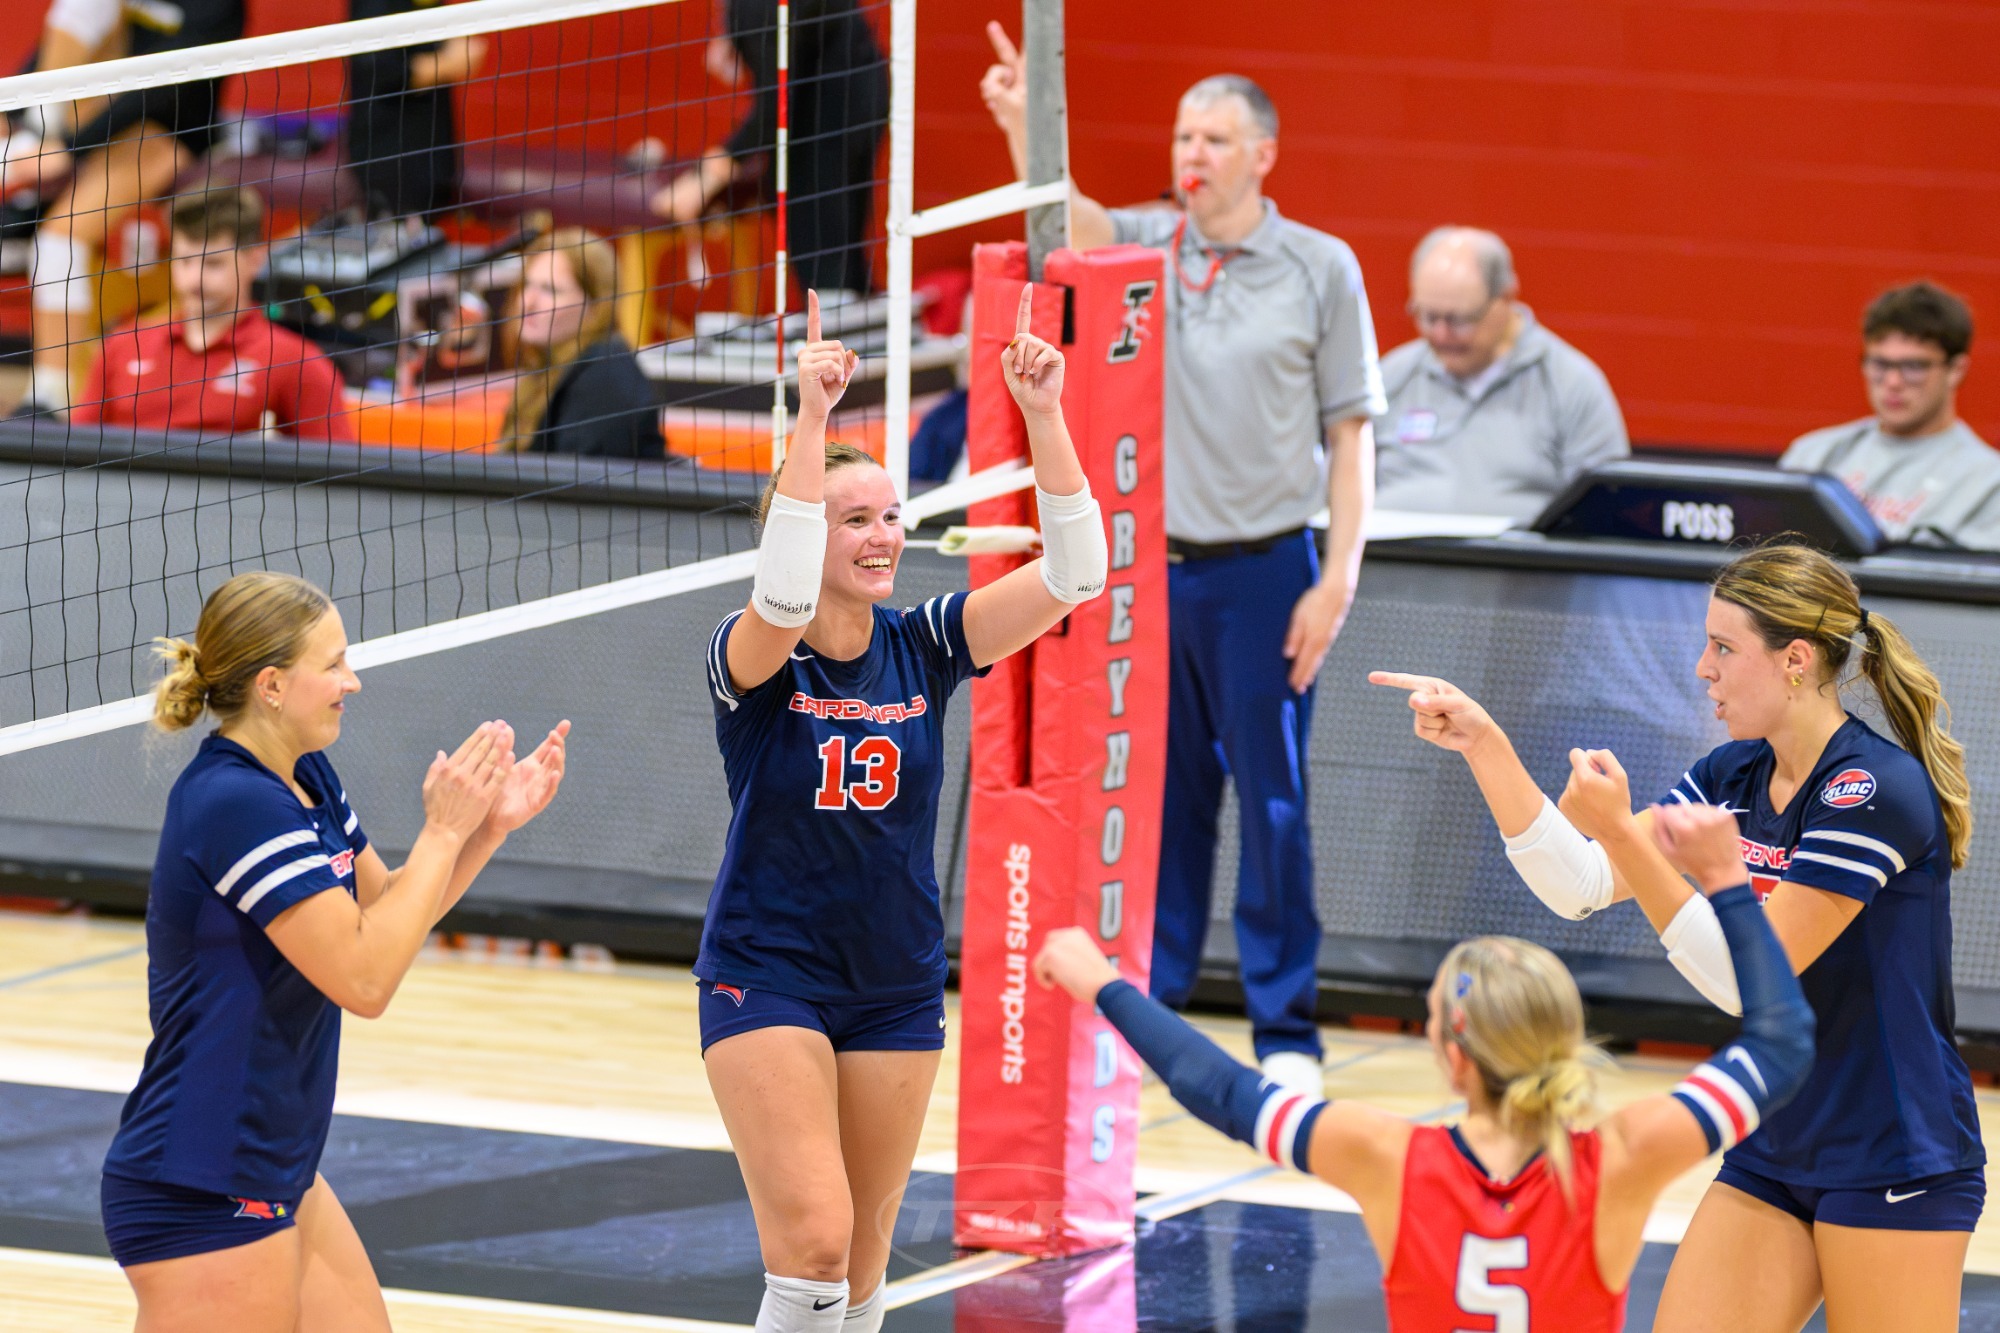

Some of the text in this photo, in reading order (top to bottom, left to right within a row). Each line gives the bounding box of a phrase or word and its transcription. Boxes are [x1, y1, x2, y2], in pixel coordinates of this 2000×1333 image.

[1662, 501, 1734, 541] POSS
[788, 692, 927, 724] CARDINALS
[814, 735, 901, 811] 13
[1091, 434, 1139, 1163] GREYHOUDS
[1000, 843, 1031, 1084] sports imports
[1452, 1231, 1530, 1333] 5
